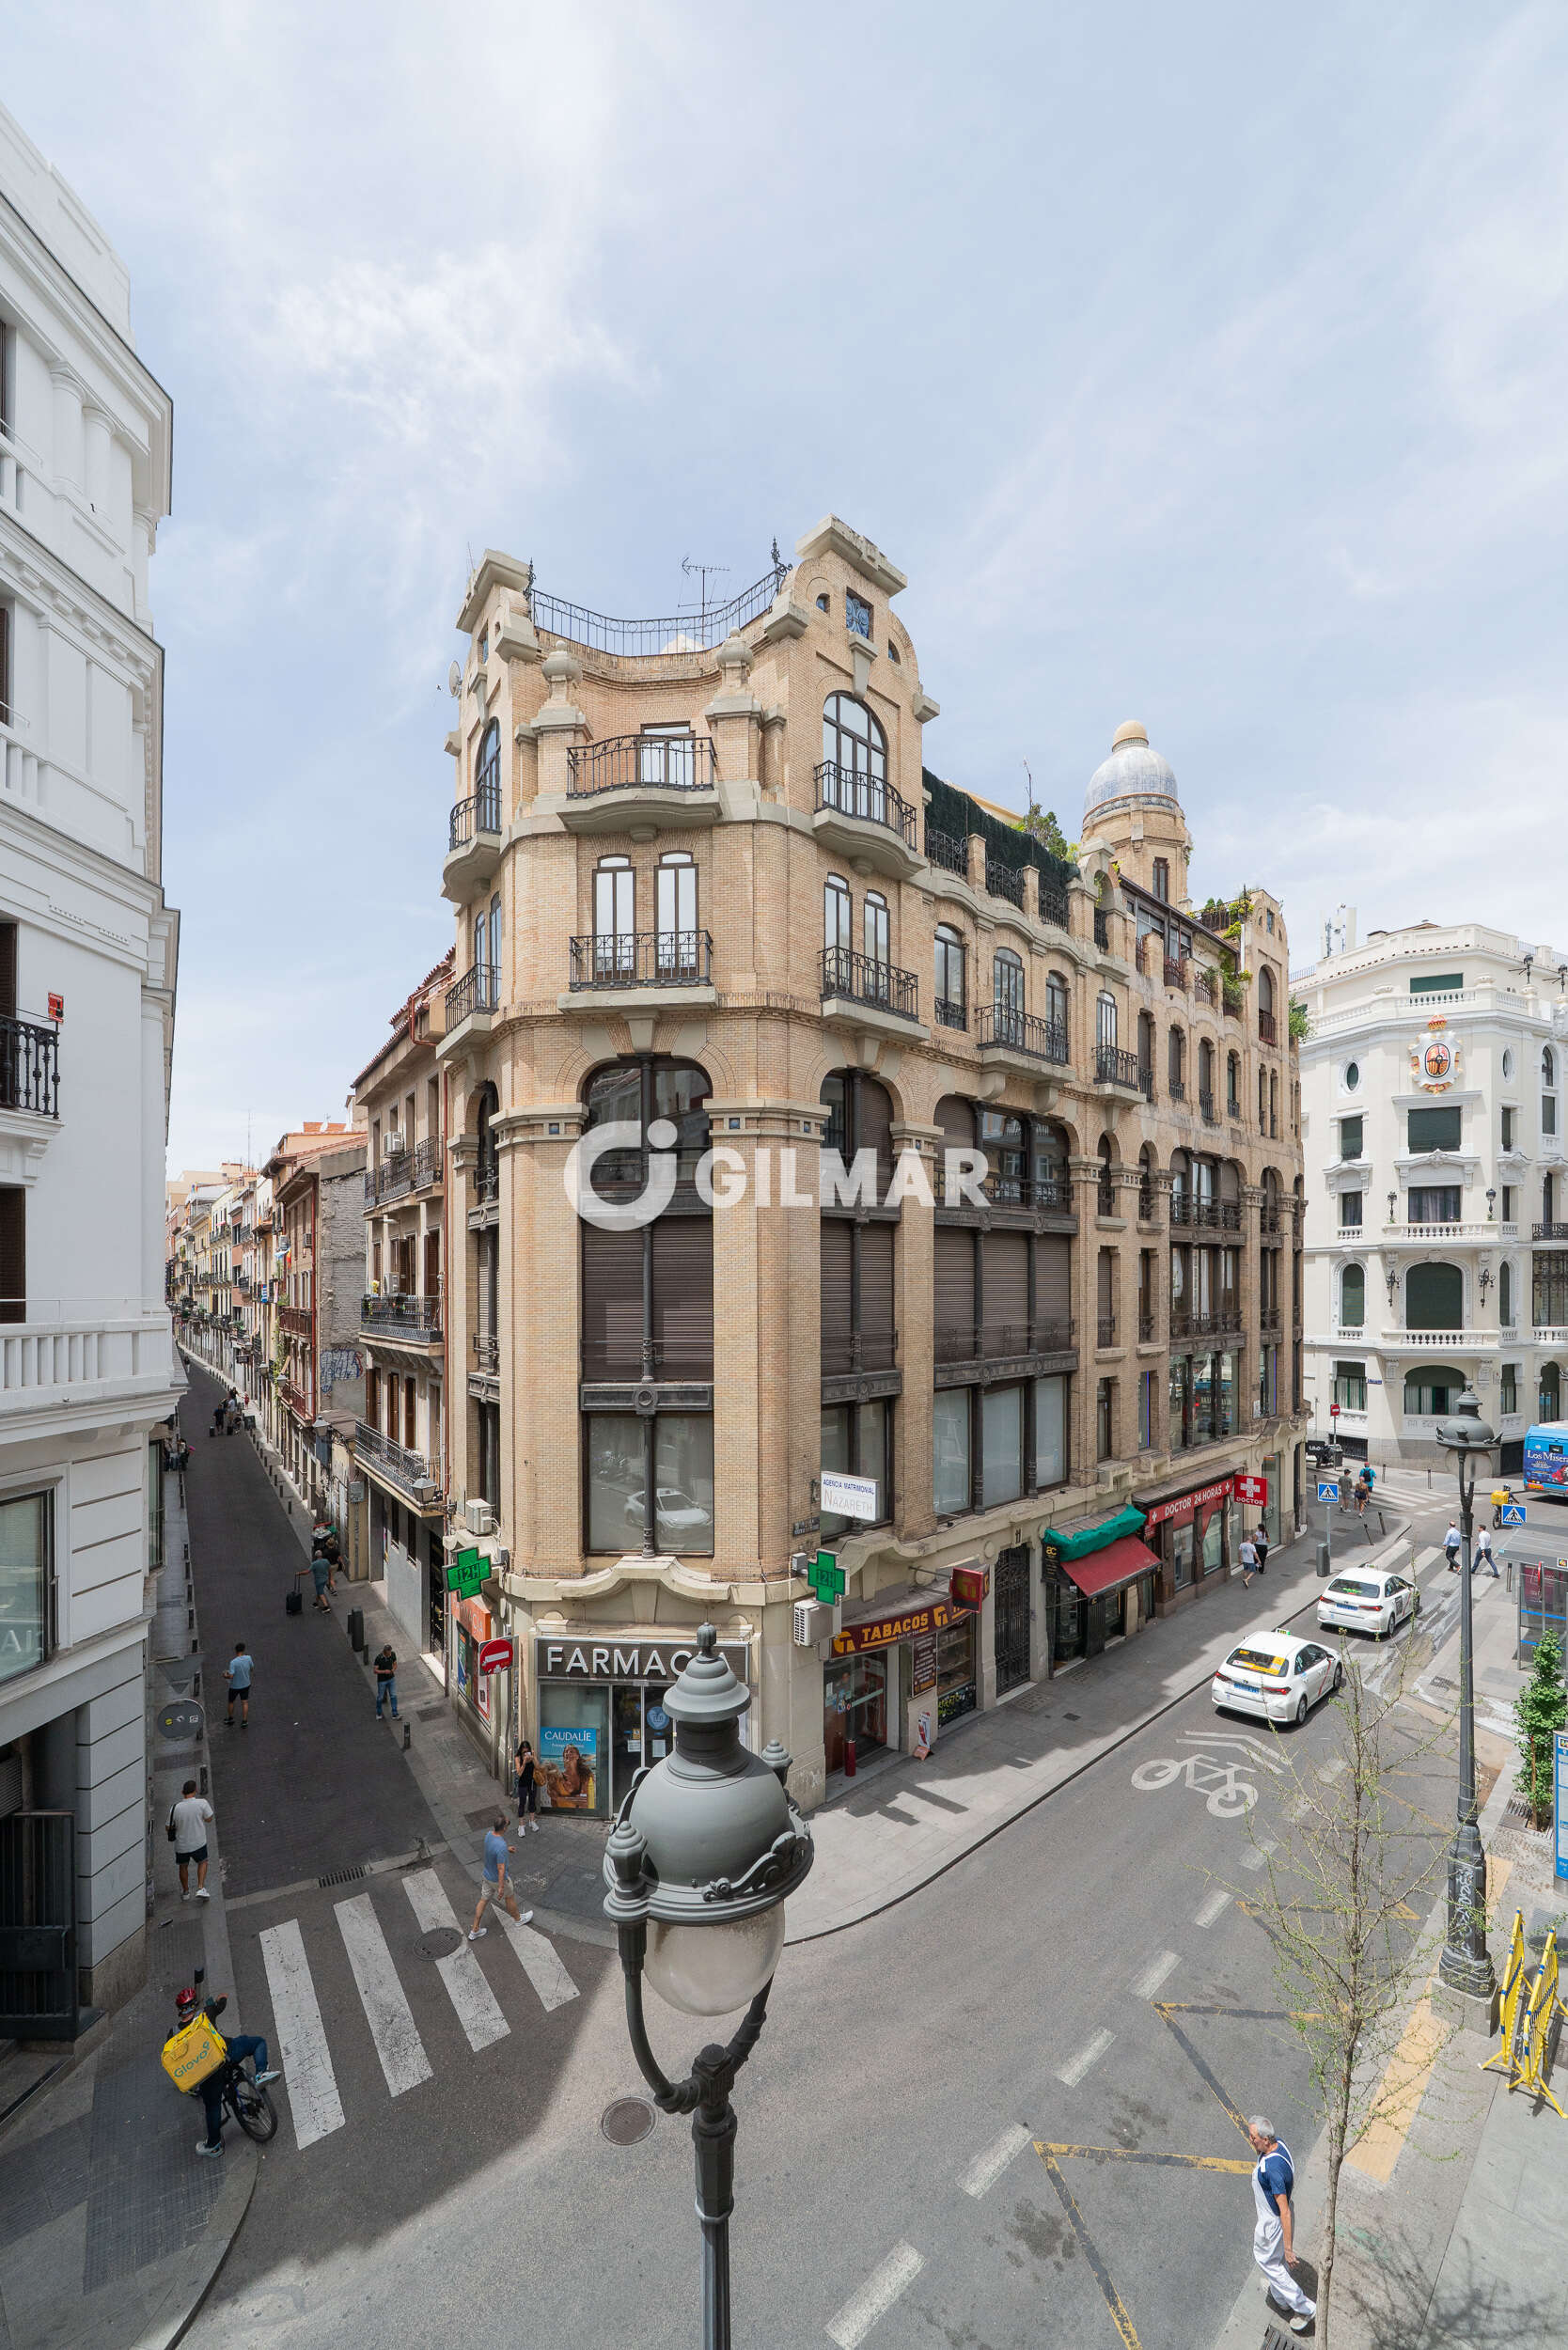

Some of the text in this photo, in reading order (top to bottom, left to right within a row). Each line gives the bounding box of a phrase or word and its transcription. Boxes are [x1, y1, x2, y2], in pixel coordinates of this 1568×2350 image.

[823, 1479, 874, 1496] AGENCIA MATRIMONIAL
[1165, 1485, 1223, 1516] DOCTOR 24 HORAS
[1235, 1496, 1264, 1506] DOCTOR
[458, 1562, 481, 1585] 12H
[862, 1612, 929, 1642] TABACOS
[547, 1646, 731, 1677] FARMAC
